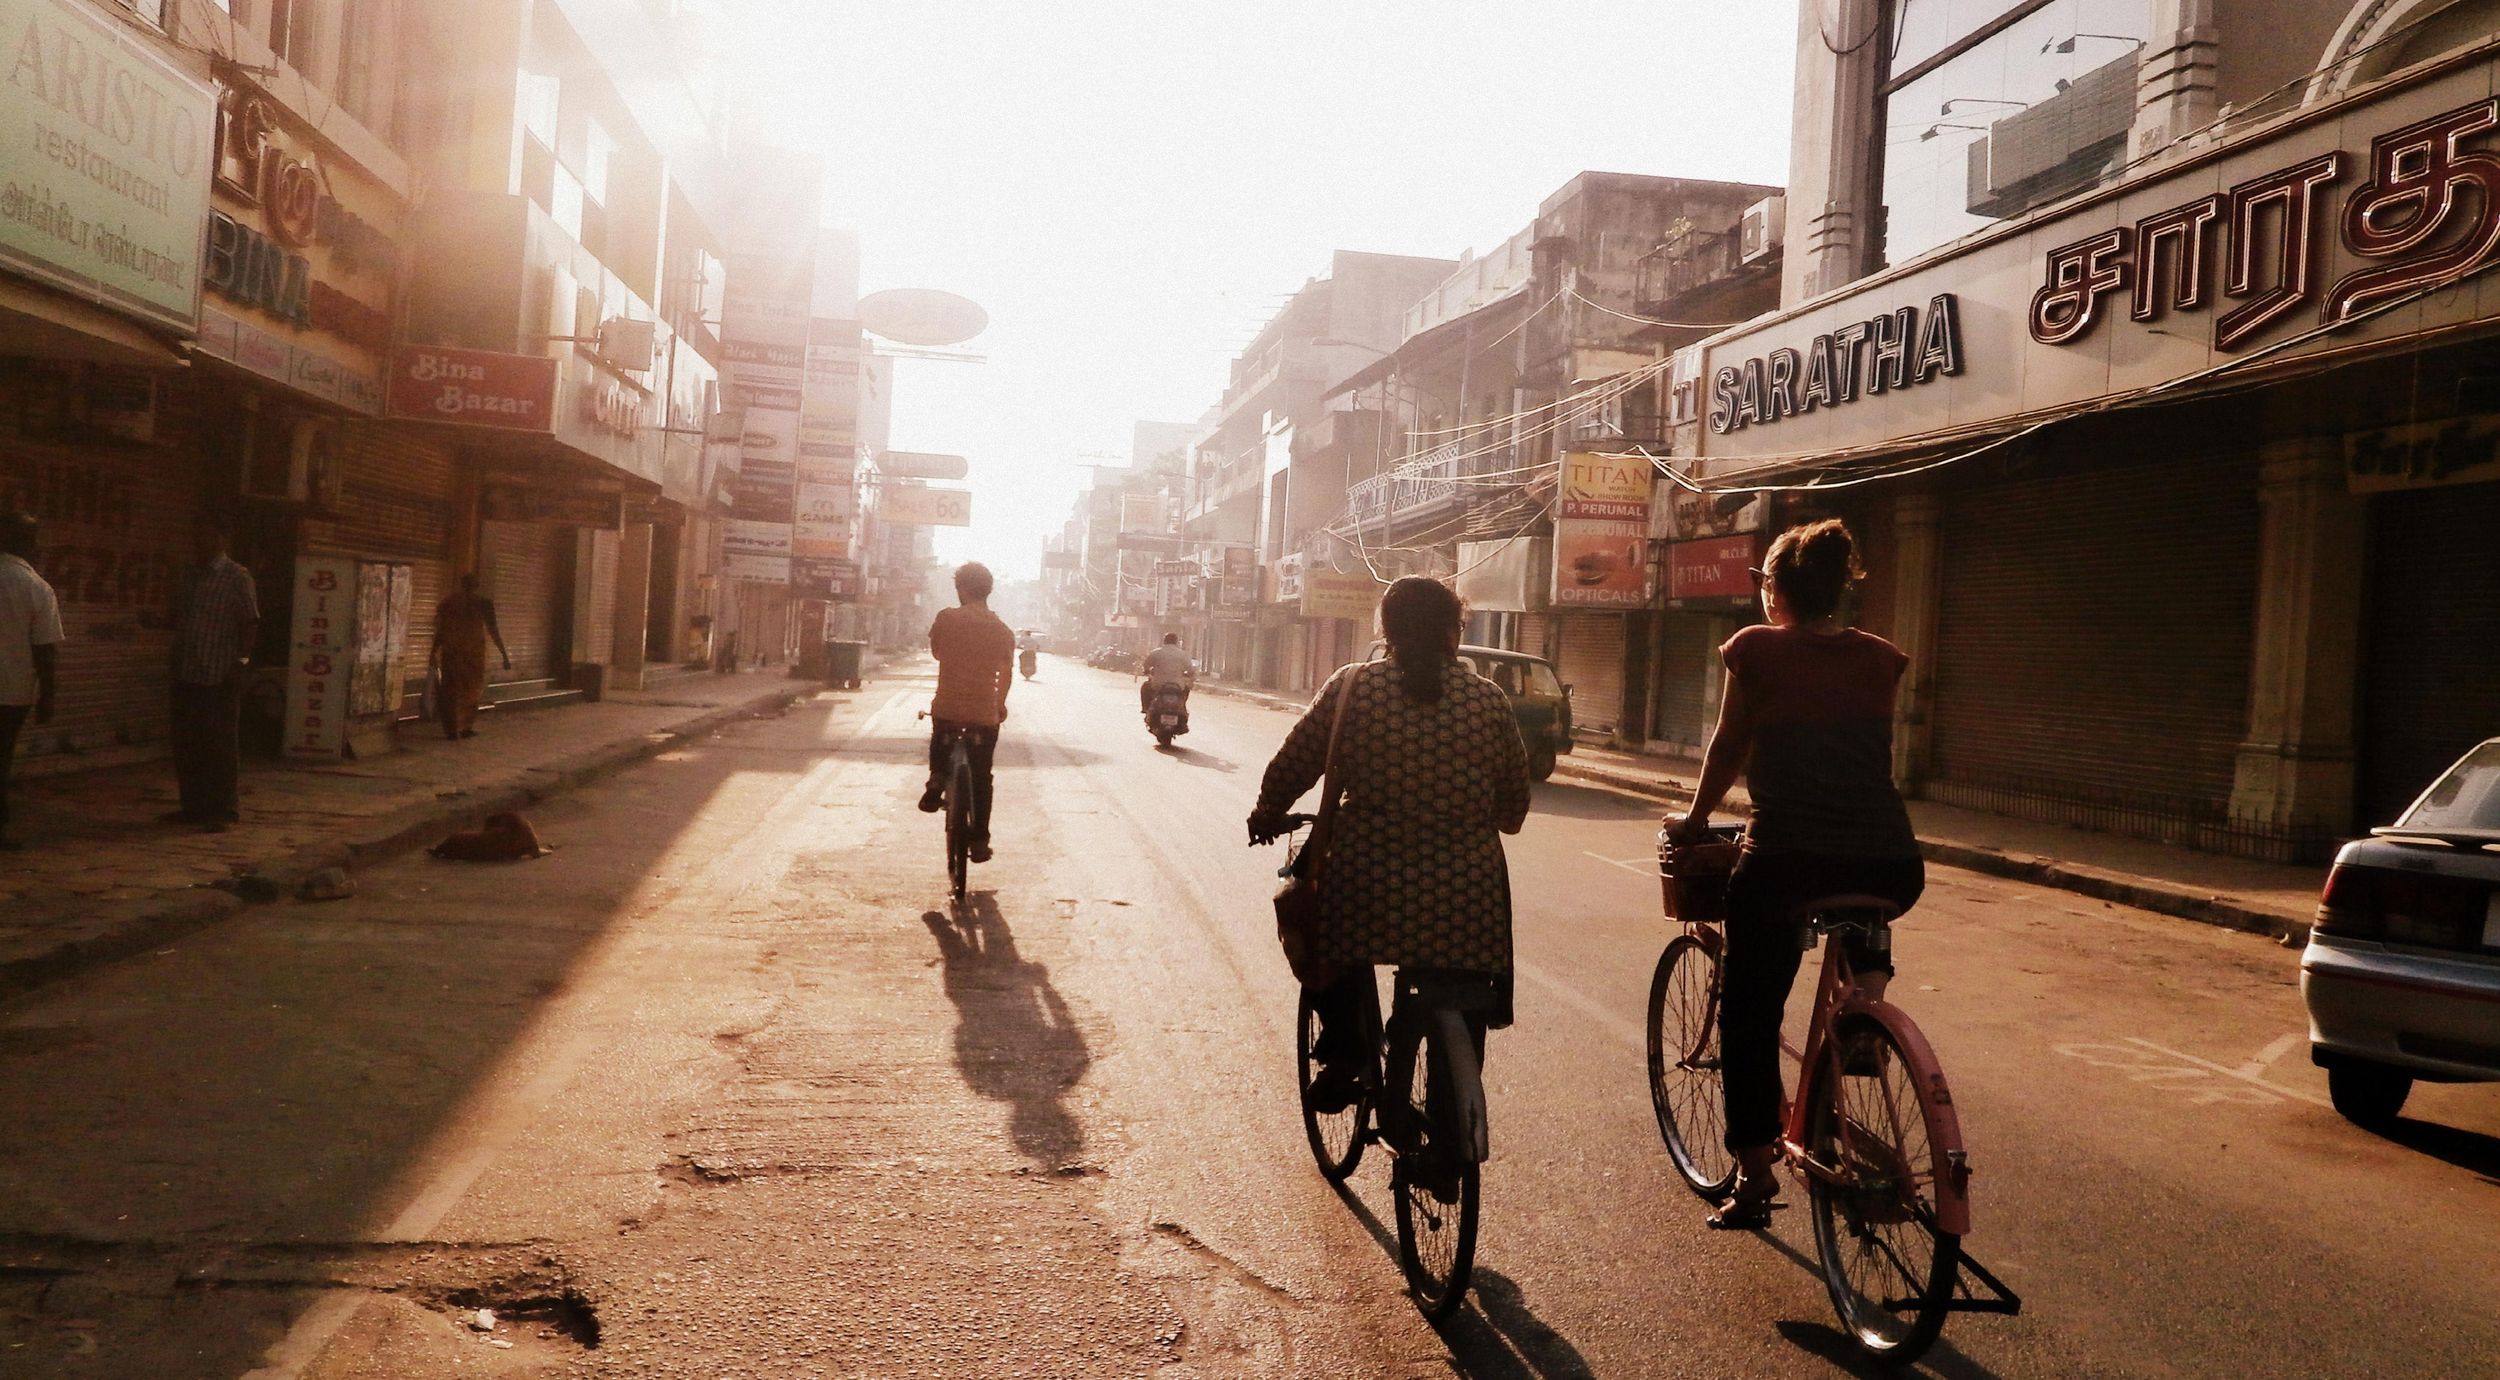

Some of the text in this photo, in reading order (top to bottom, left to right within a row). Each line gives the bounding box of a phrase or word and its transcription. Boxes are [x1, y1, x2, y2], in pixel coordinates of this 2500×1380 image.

[6, 14, 199, 180] ARISTO
[33, 121, 171, 218] restaurant
[411, 354, 486, 382] Bina
[1708, 293, 1962, 435] SARATHA
[434, 385, 535, 415] Bazar
[1570, 463, 1649, 485] TITAN
[1567, 502, 1644, 517] P. PERUMAL
[1687, 564, 1720, 583] TITAN
[308, 570, 338, 645] Bina
[1561, 588, 1641, 603] OPTICALS
[303, 654, 332, 746] Bazar
